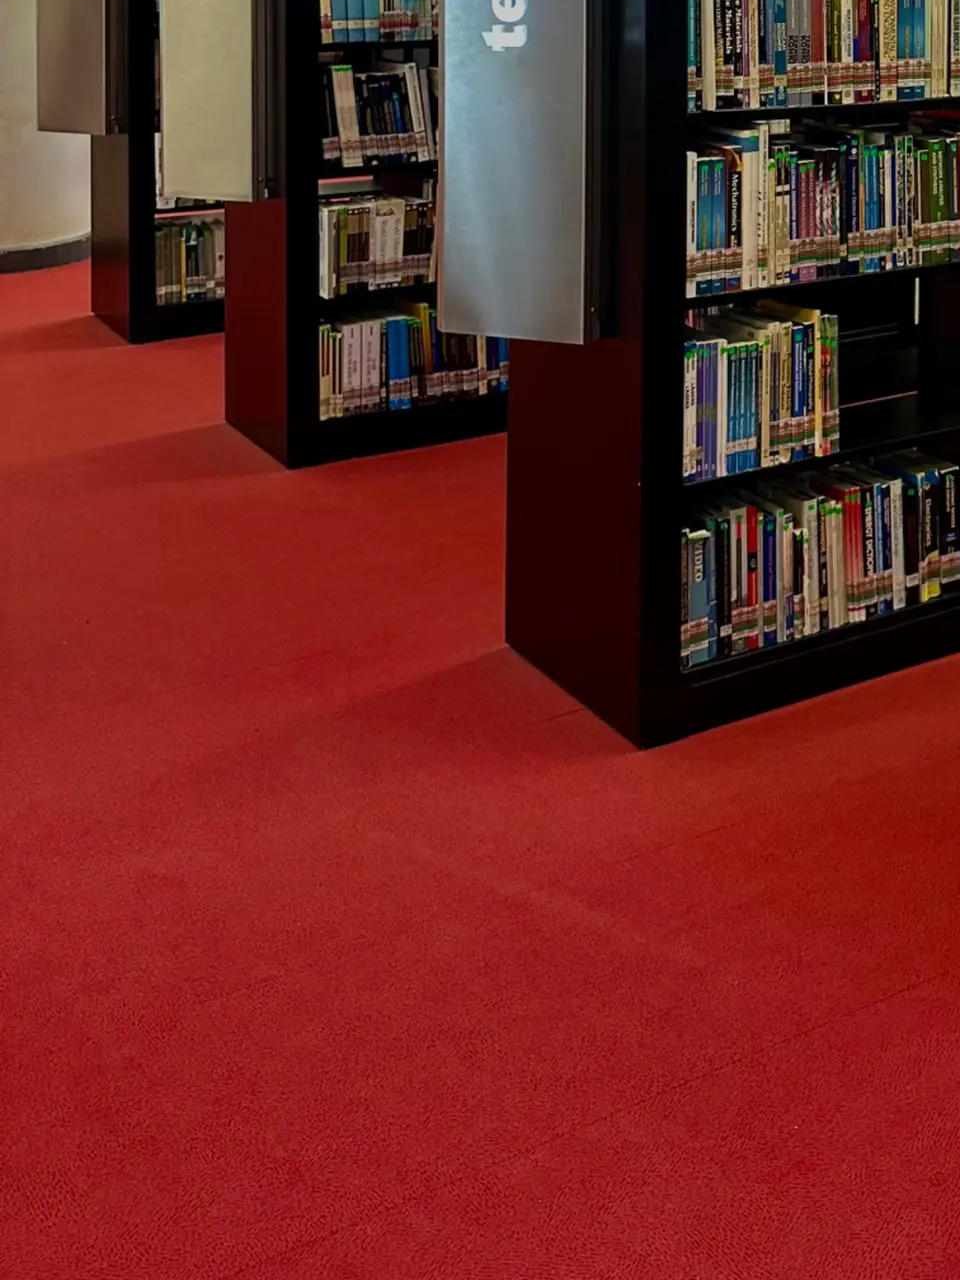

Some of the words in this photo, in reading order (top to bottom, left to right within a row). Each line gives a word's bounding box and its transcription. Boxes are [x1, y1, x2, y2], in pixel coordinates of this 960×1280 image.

[725, 8, 733, 55] Materials
[730, 173, 740, 232] Mechatronics
[924, 498, 934, 547] Electronics
[864, 539, 874, 578] DICTION
